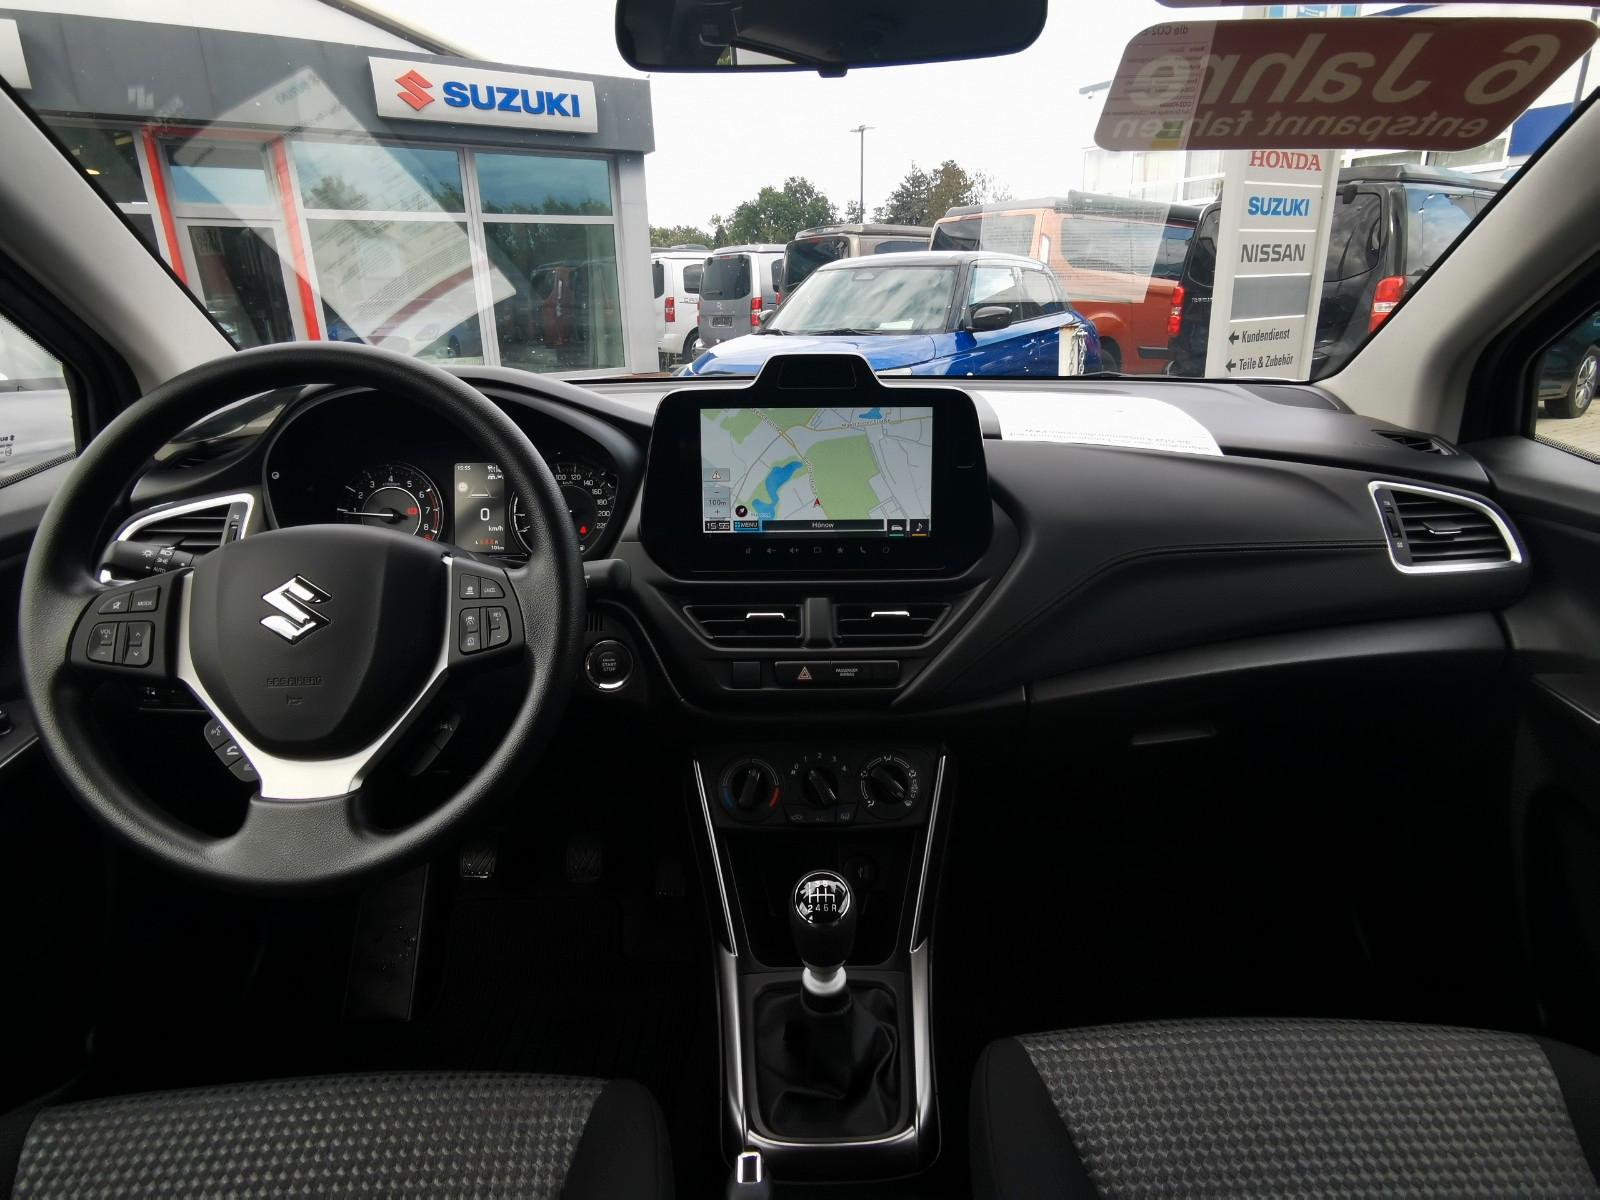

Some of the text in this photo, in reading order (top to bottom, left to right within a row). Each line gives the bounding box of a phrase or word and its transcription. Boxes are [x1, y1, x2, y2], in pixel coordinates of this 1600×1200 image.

[442, 81, 581, 118] SUZUKI
[1248, 151, 1322, 171] HONDA
[1248, 196, 1310, 217] SUZUKI
[1241, 243, 1306, 263] NISSAN
[1241, 328, 1290, 343] Kundendienst
[1239, 354, 1294, 371] Teile & Zubehör
[369, 480, 375, 488] 3
[406, 480, 413, 488] 5
[358, 491, 364, 499] 2
[418, 491, 425, 499] 6
[425, 506, 431, 514] 7
[480, 507, 490, 521] 0
[423, 523, 429, 531] 8
[807, 904, 813, 913] 2
[815, 904, 821, 912] 4
[823, 904, 829, 912] 6
